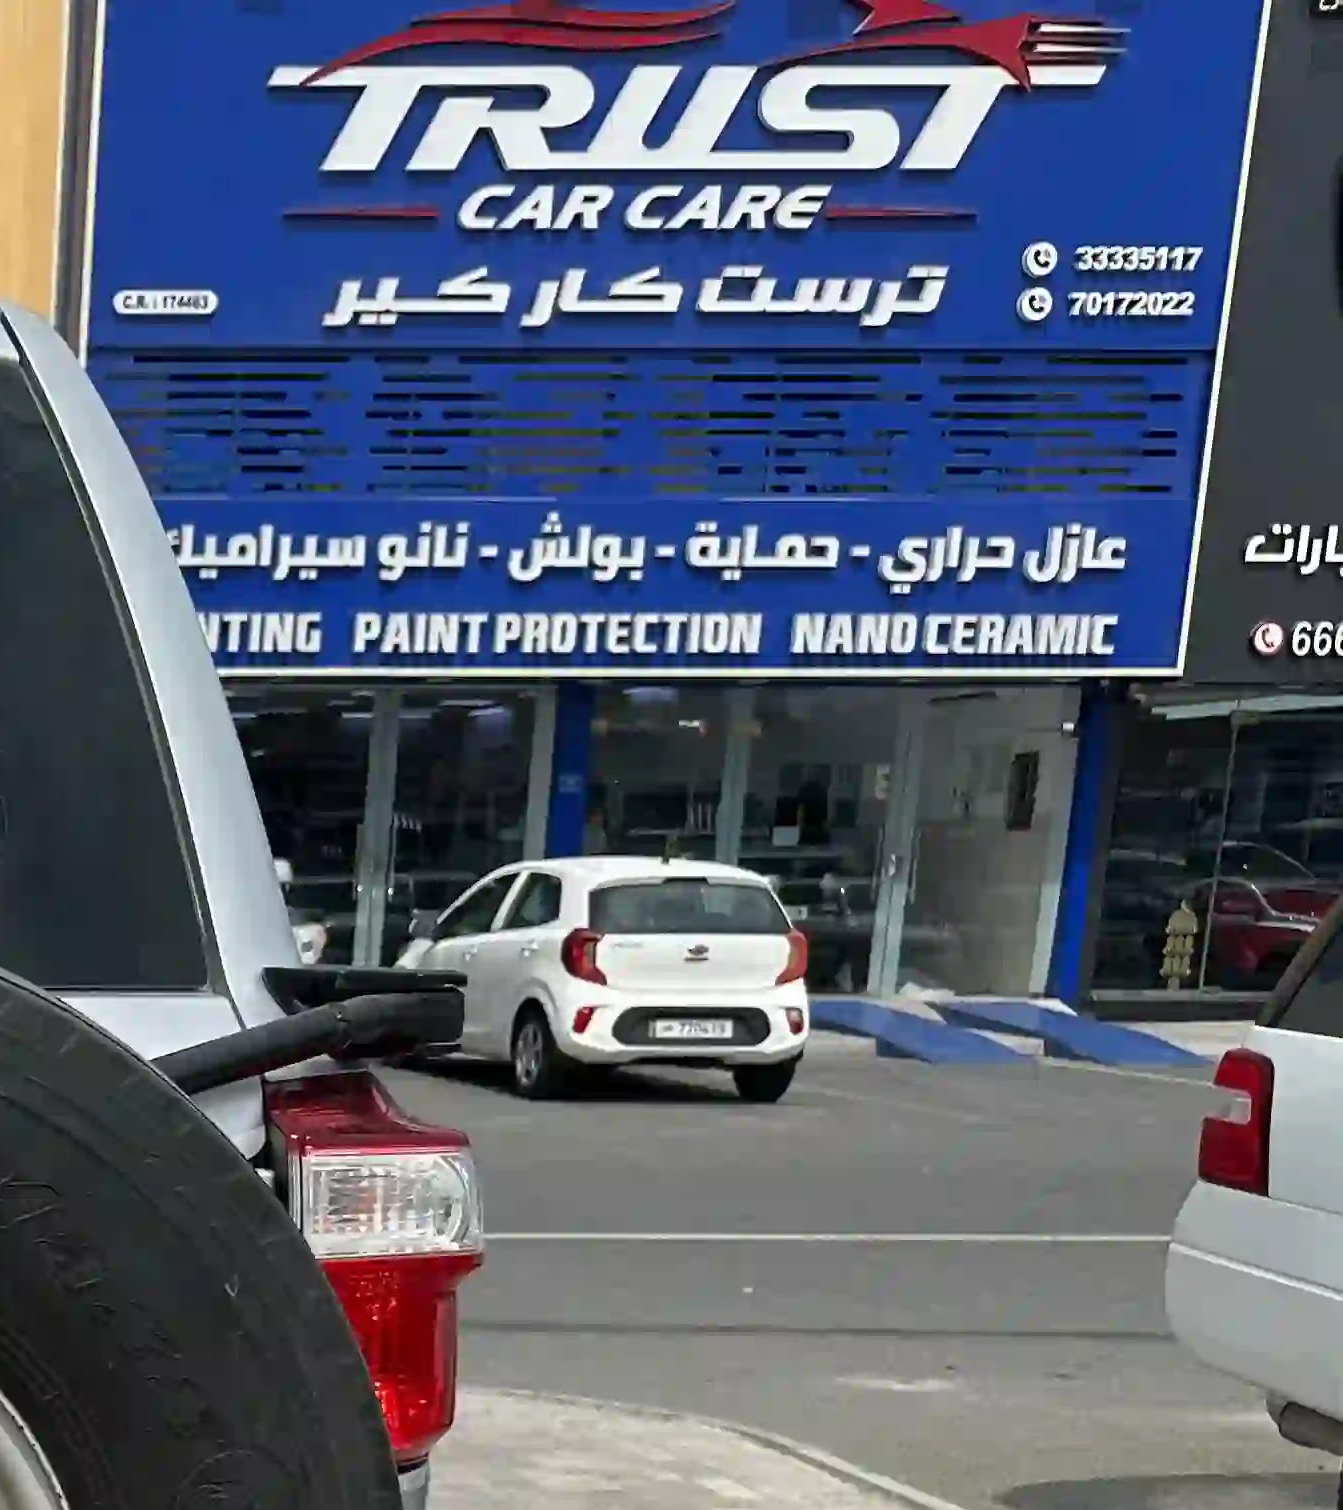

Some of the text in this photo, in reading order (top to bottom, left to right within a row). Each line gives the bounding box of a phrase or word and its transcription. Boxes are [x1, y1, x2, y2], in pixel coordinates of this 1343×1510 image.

[266, 65, 1106, 170] TRUST
[458, 184, 833, 230] CAR CARE
[1074, 246, 1203, 271] 33335117
[322, 265, 949, 328] ترست كار كير
[1067, 291, 1195, 316] 70172022
[378, 521, 472, 581] نانو
[508, 512, 646, 582] بولش
[685, 521, 839, 580] حماية
[877, 525, 1016, 594] حراري
[1023, 522, 1127, 582] عازل
[1244, 523, 1343, 577] ارات
[195, 612, 1119, 655] NTING PAINT PROTECTION NANO CERAMIC
